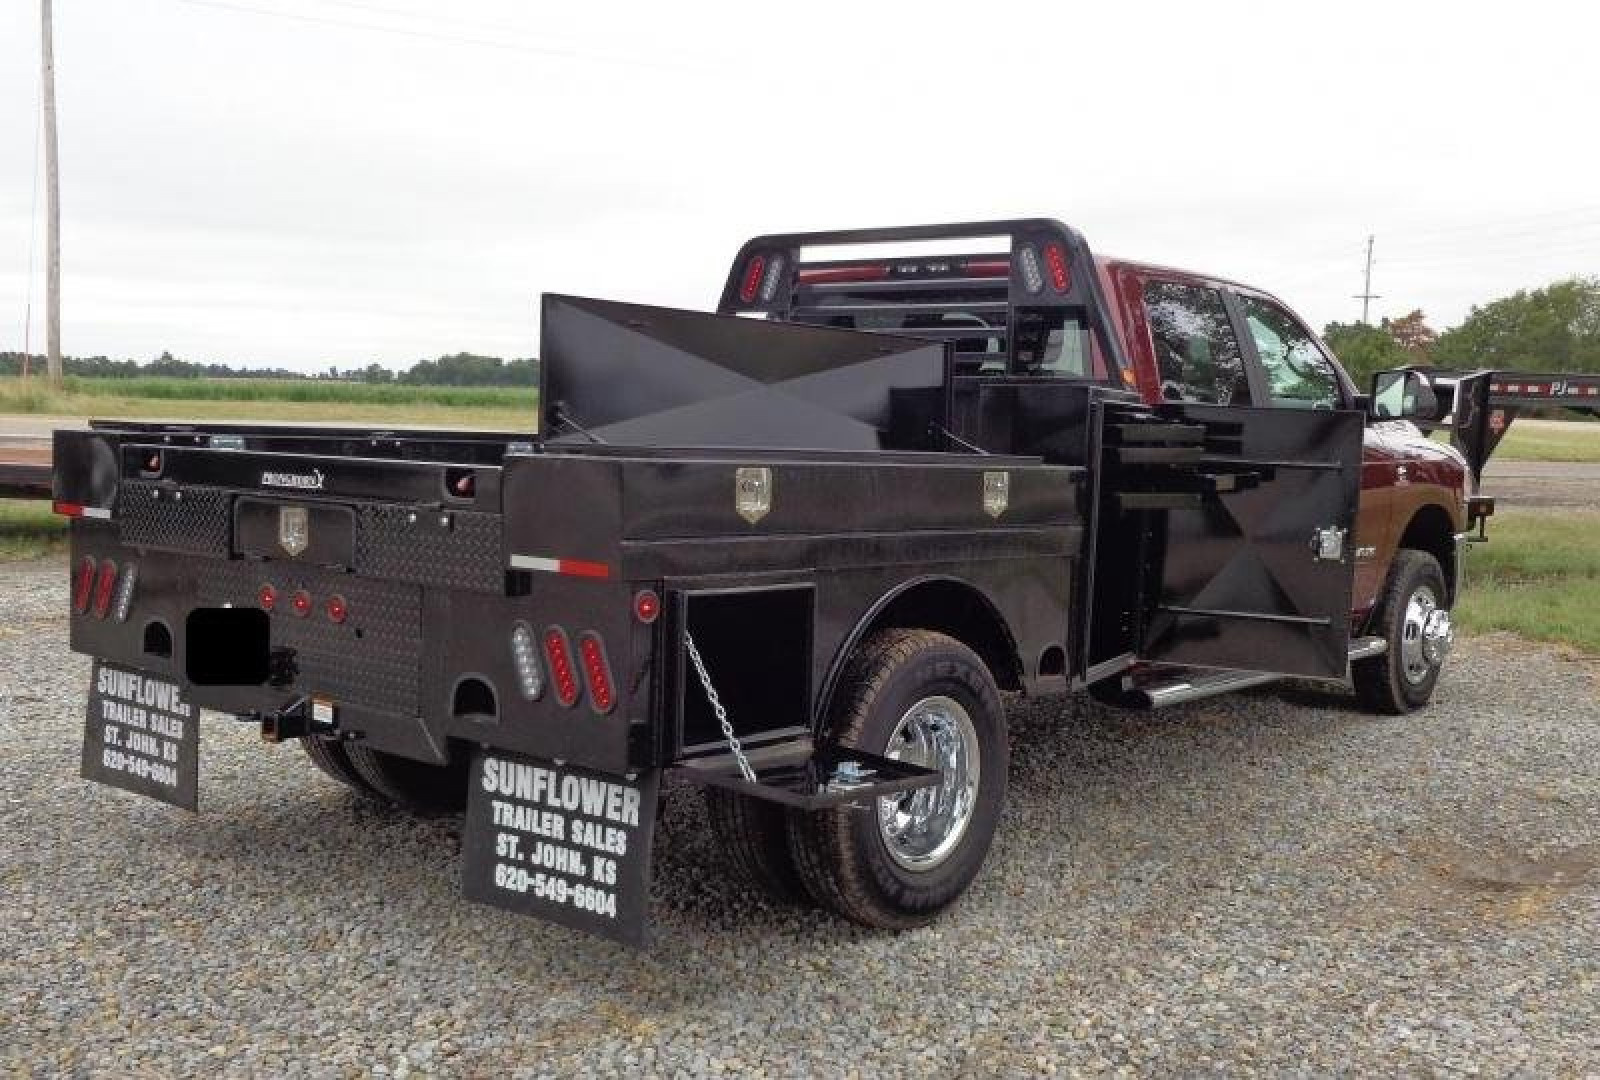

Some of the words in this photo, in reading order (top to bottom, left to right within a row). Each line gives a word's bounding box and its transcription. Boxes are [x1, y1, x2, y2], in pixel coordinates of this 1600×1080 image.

[102, 699, 147, 729] TRAILER
[151, 713, 183, 740] SALES
[104, 724, 123, 747] ST.
[163, 740, 178, 763] KS
[482, 757, 641, 827] SUNFLOWER
[492, 800, 565, 841] TRAILER
[571, 819, 627, 856] SALES
[496, 832, 524, 861] ST.
[593, 855, 617, 885] KS
[495, 862, 617, 919] 620-549-6604
